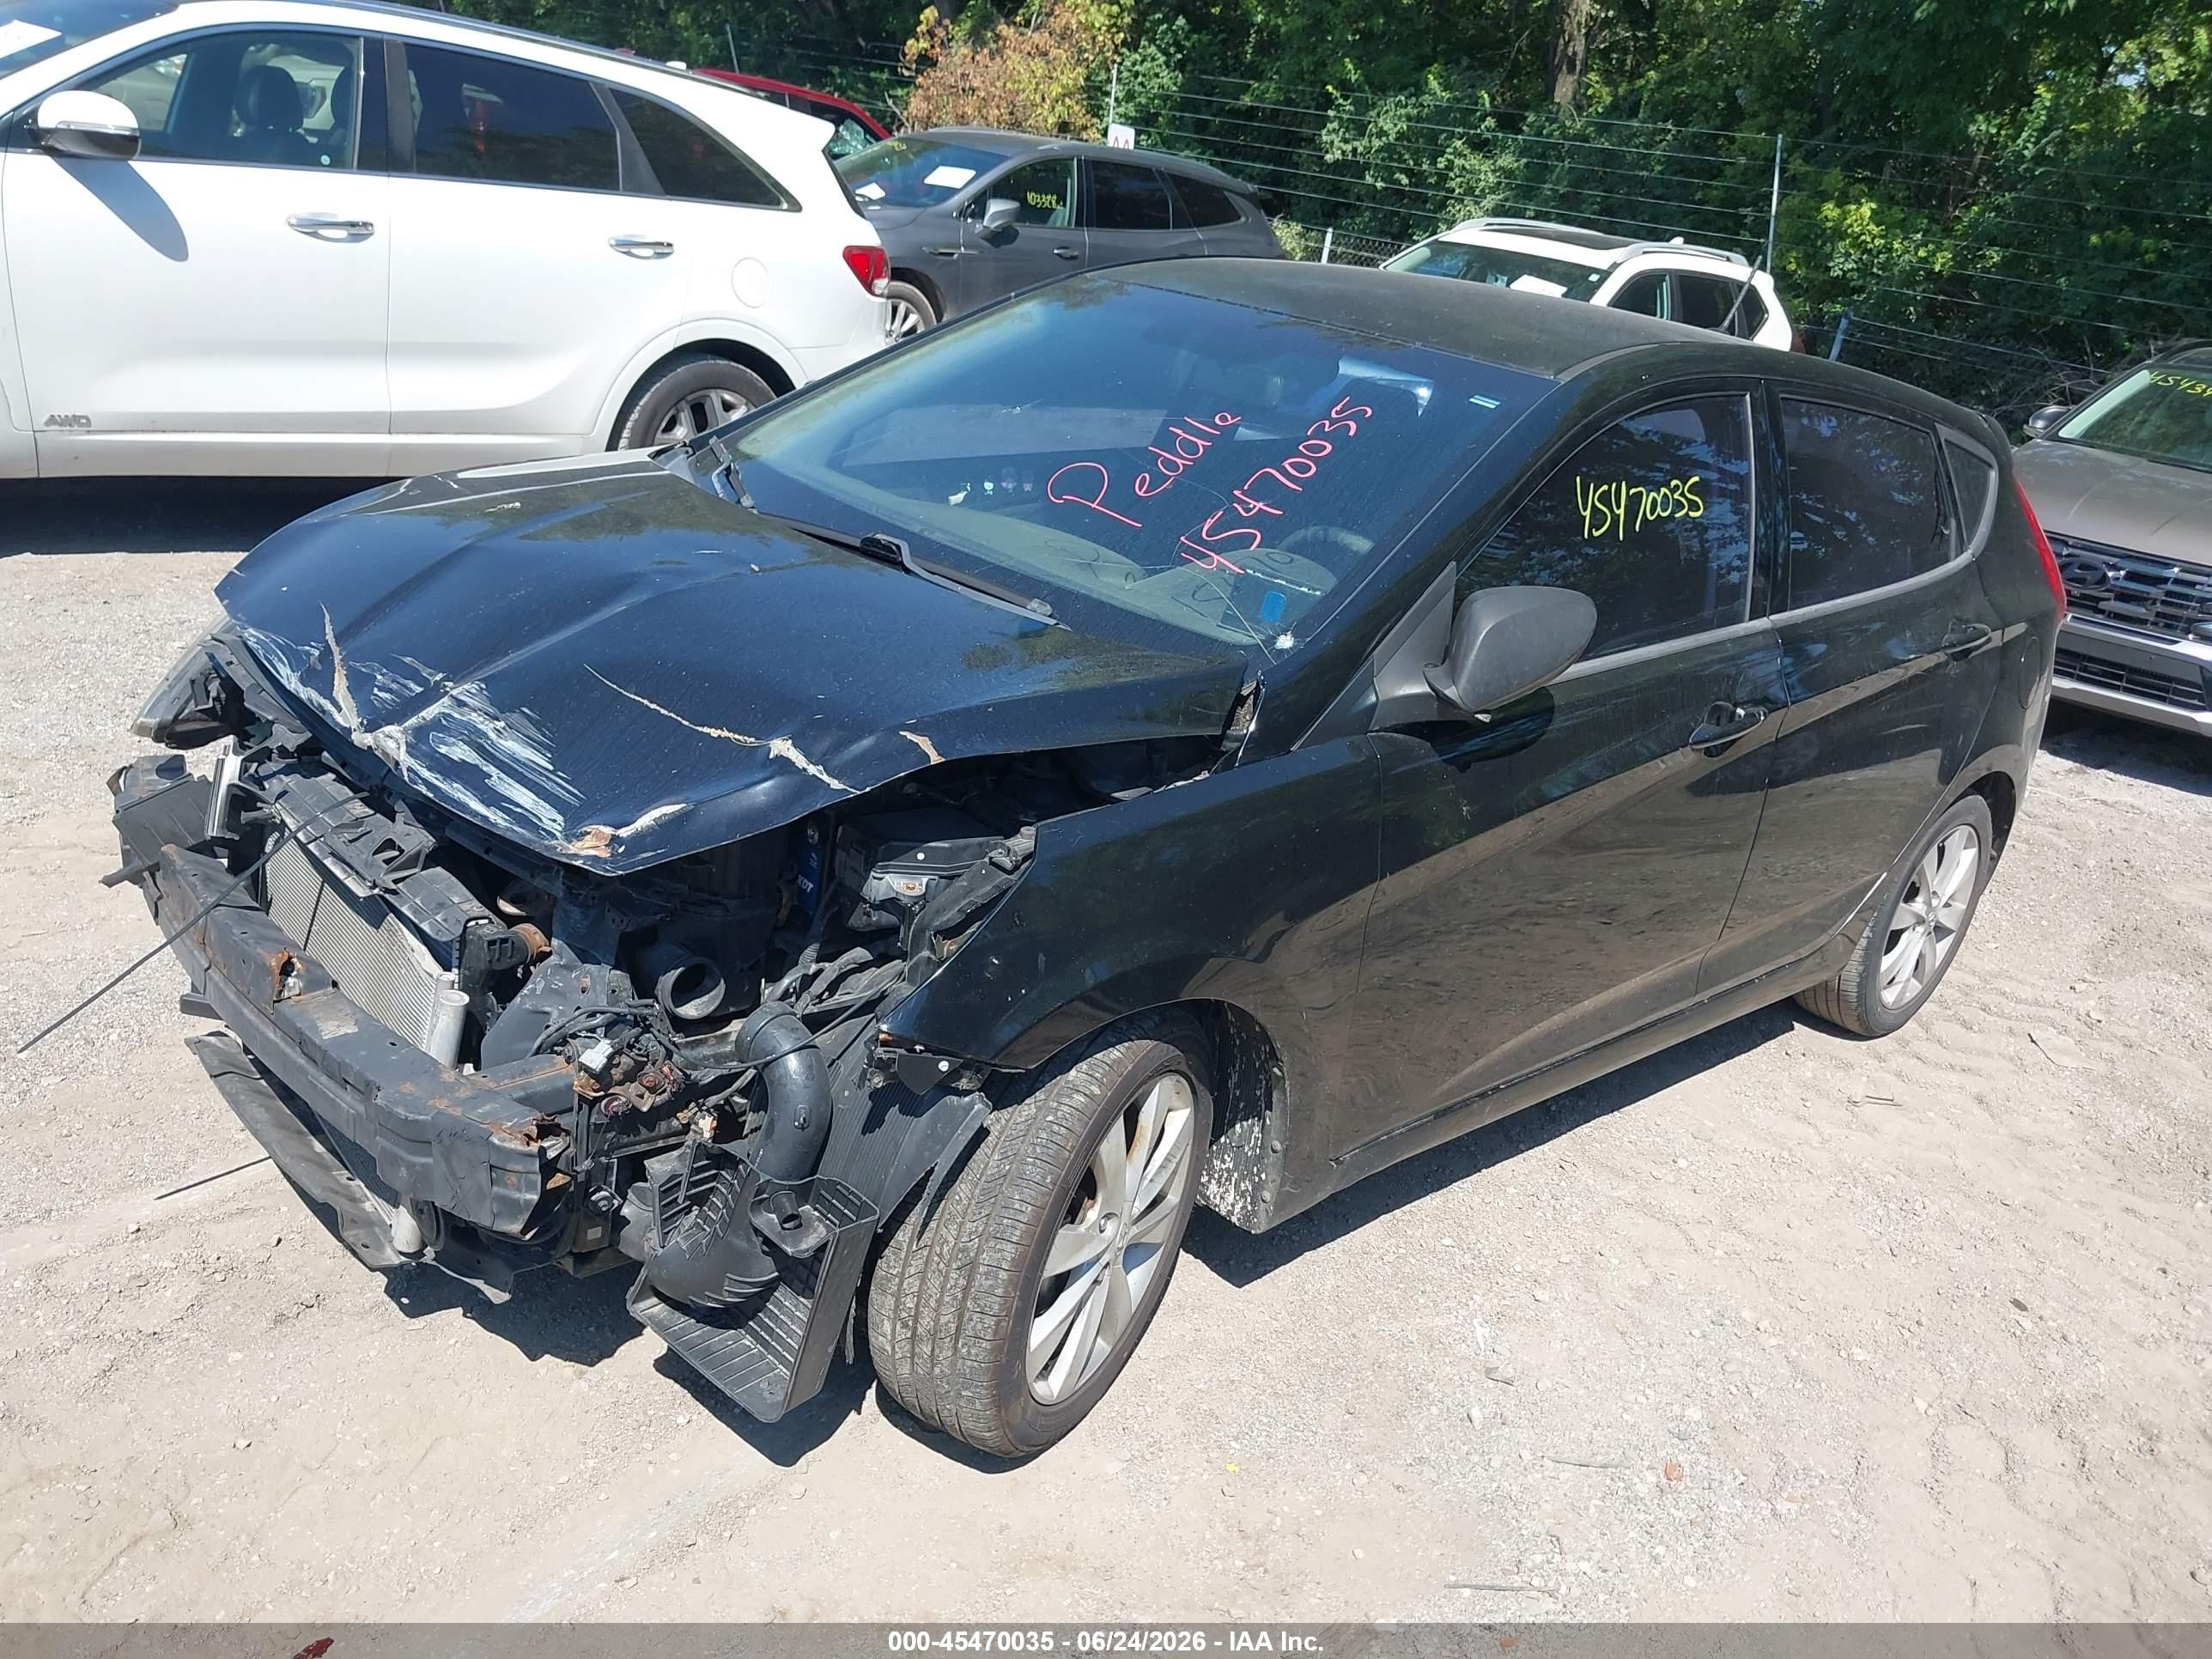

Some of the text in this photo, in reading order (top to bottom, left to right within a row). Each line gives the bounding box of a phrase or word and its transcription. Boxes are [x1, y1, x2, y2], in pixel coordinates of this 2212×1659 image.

[44, 414, 92, 428] AWD
[1047, 410, 1242, 528] Peddle
[1180, 396, 1373, 574] 45470035
[1576, 475, 1704, 542] 45470035
